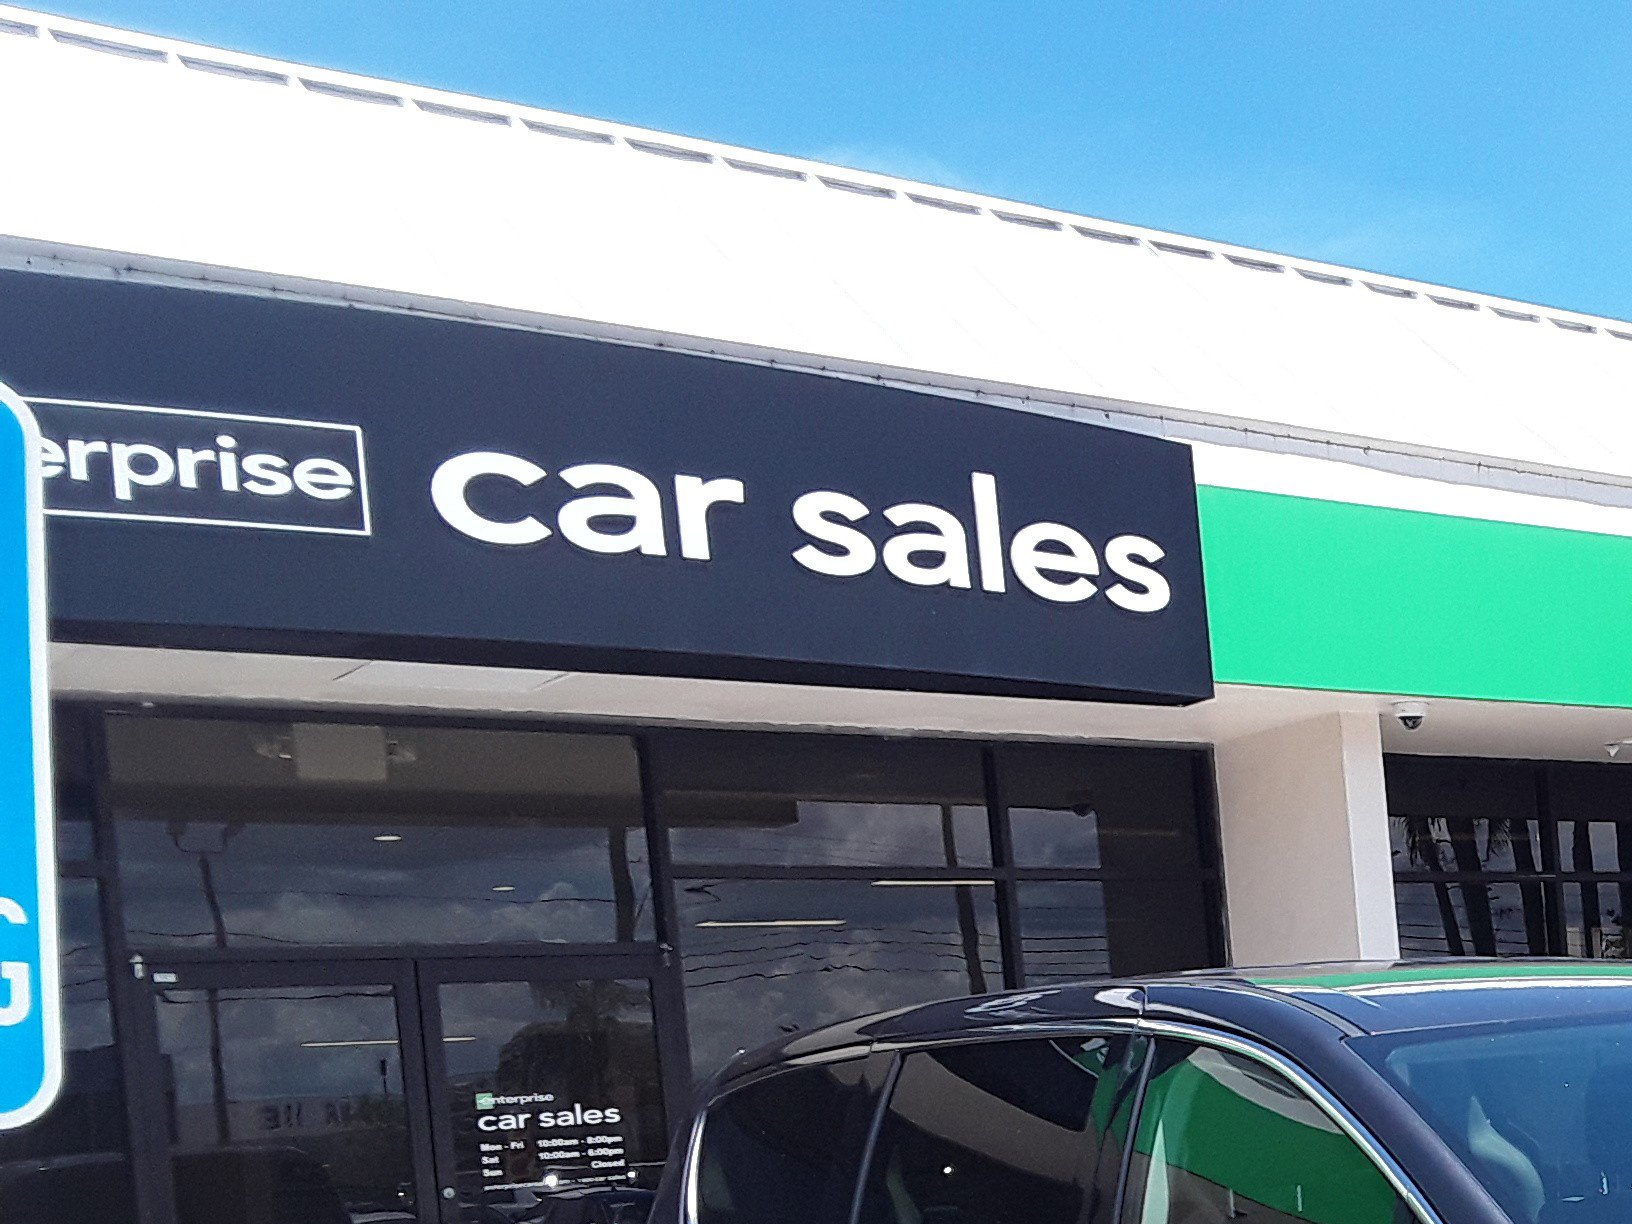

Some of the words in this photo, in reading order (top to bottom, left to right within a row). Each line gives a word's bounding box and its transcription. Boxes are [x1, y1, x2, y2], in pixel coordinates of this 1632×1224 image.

[430, 450, 745, 562] car
[791, 471, 1171, 613] sales
[482, 1093, 555, 1106] enterprise
[477, 1112, 531, 1132] car
[538, 1103, 621, 1128] sales
[510, 1141, 525, 1150] Fri
[481, 1156, 500, 1164] Sat
[591, 1158, 626, 1169] Closed
